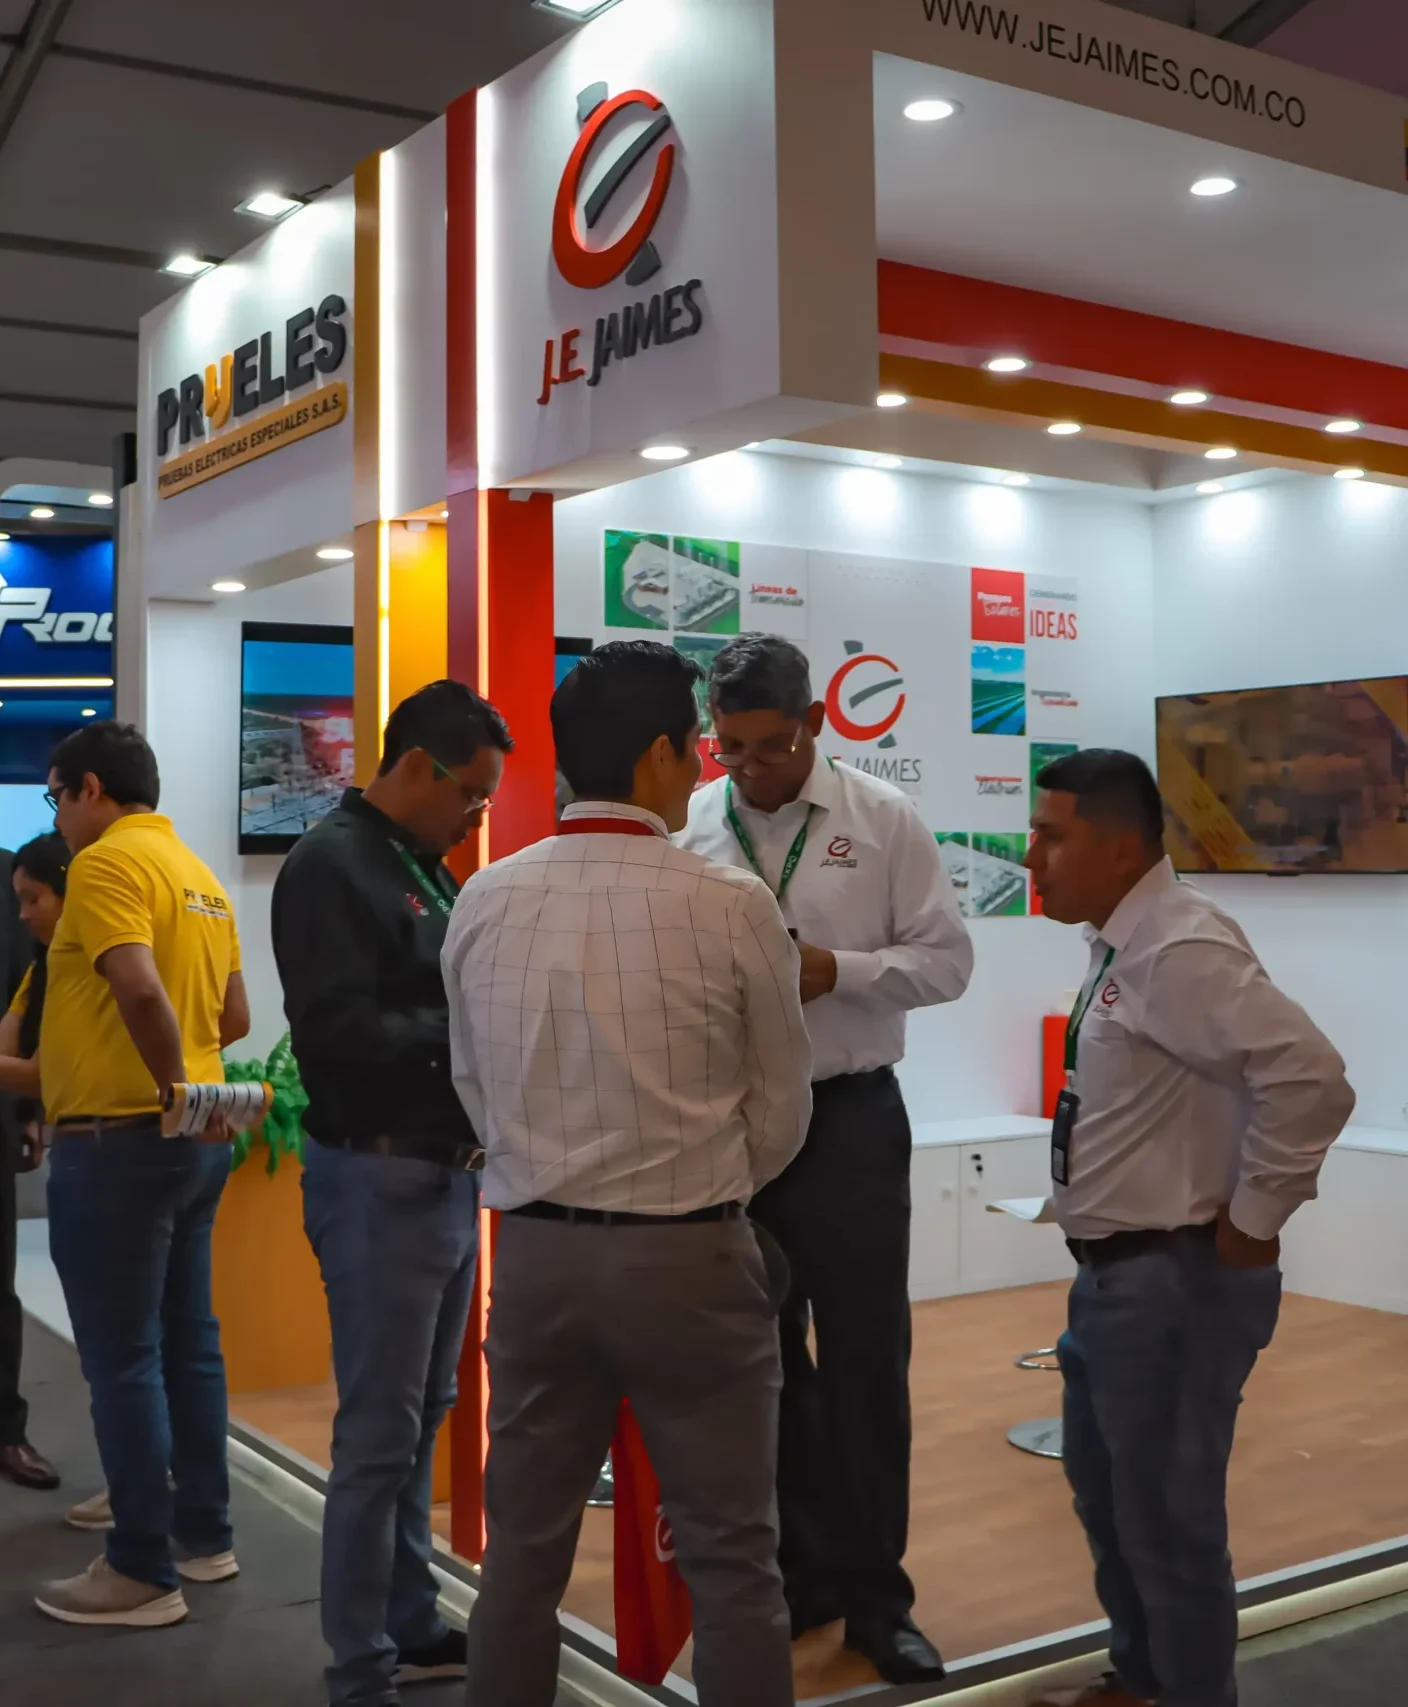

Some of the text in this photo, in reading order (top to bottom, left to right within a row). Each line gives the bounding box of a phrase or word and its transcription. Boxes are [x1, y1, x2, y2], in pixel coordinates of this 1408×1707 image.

[921, 0, 1306, 128] WWW.JEJAIMES.COM.CO
[157, 294, 347, 457] PRUELES
[586, 278, 703, 387] JAIMES
[158, 462, 194, 490] PRUEBAS
[250, 408, 310, 449] ESPECIALES
[1030, 609, 1077, 640] IDEAS
